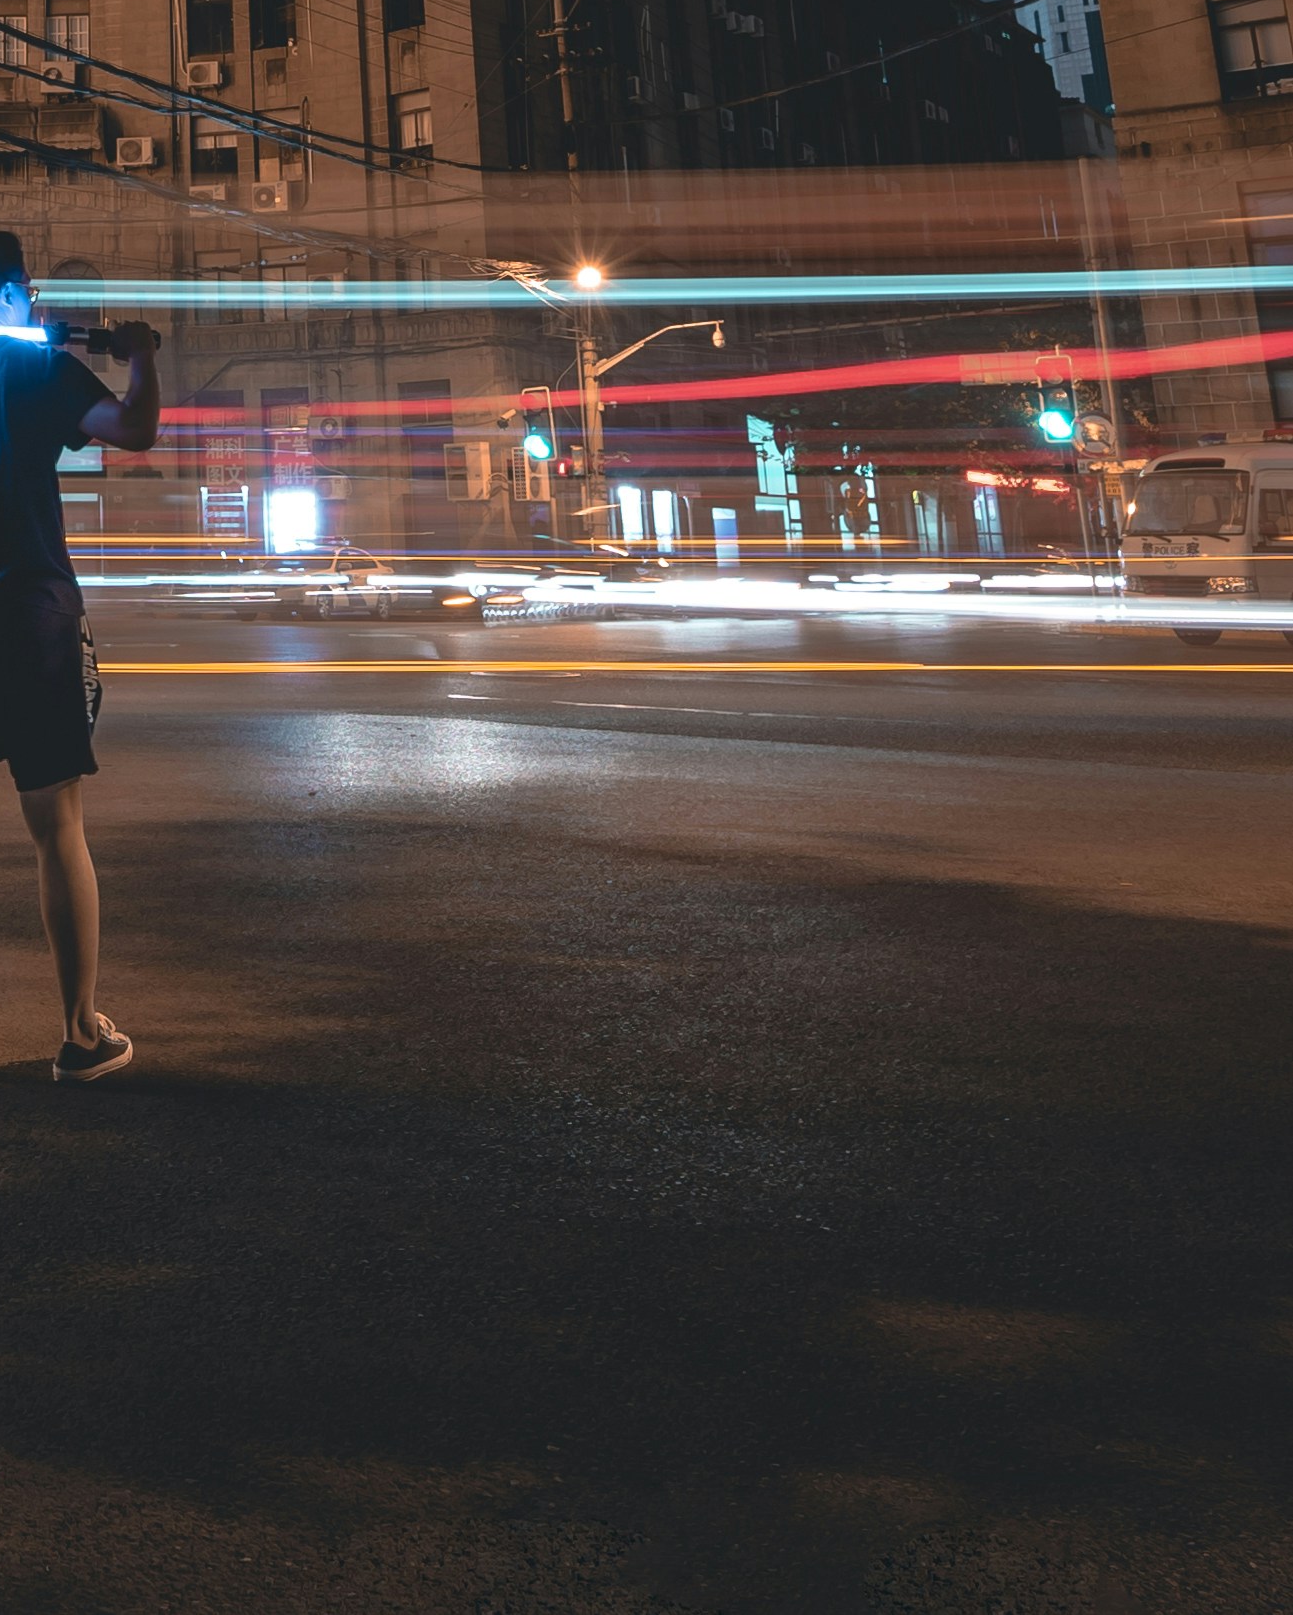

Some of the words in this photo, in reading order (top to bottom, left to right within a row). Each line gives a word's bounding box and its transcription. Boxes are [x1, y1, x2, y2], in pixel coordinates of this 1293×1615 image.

[274, 436, 309, 458] 广告
[206, 464, 244, 486] 图文
[274, 462, 312, 485] 制作
[1154, 545, 1185, 555] POLICE
